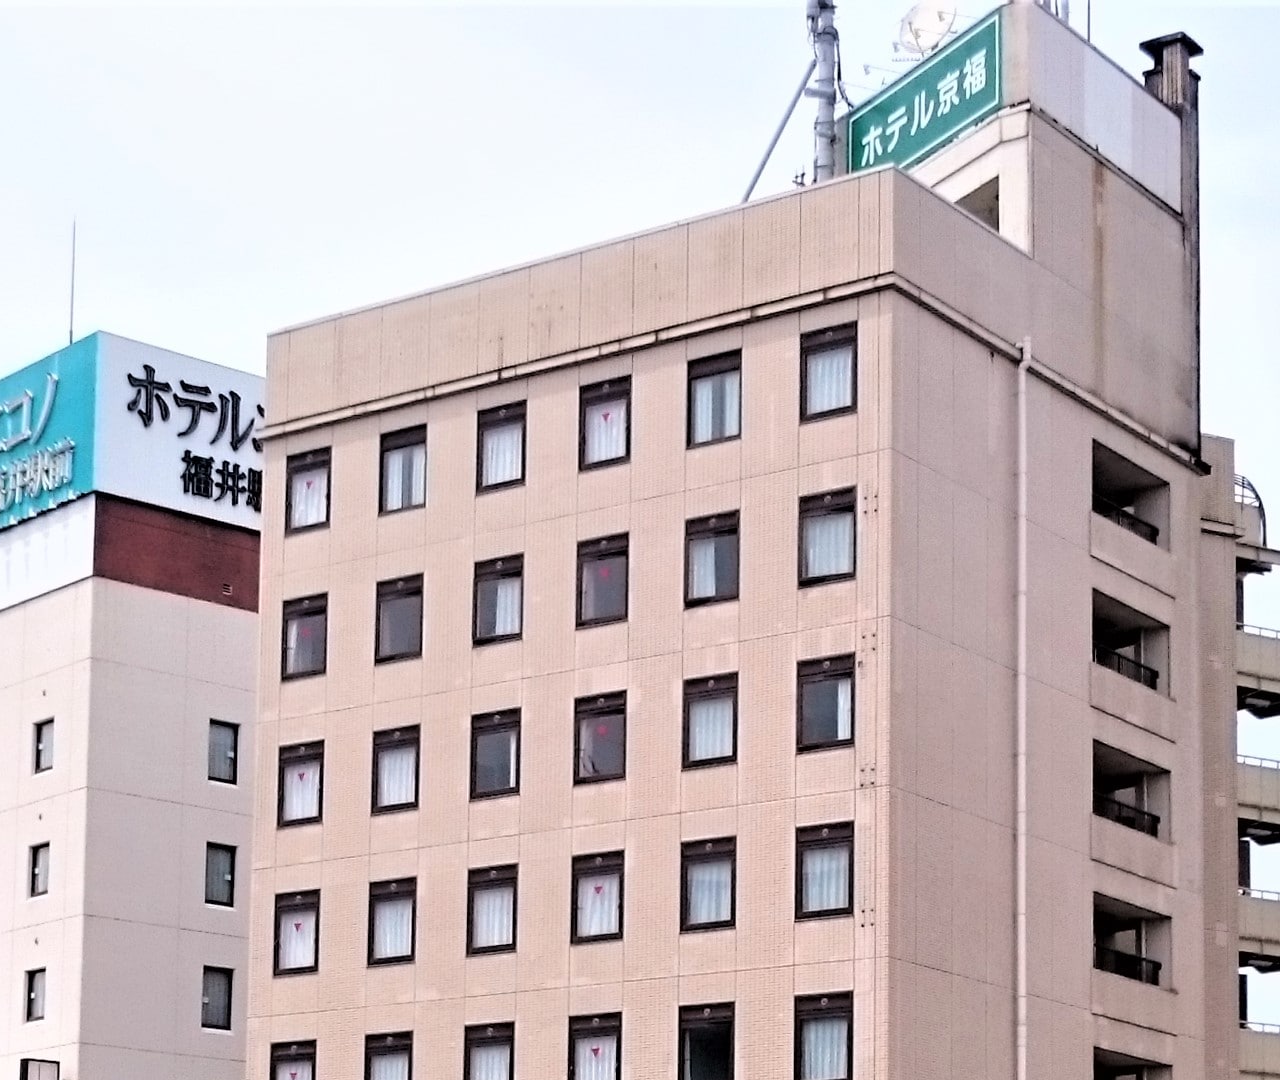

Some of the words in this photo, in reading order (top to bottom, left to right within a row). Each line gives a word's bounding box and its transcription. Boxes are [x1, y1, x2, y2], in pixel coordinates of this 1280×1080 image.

[861, 49, 987, 167] ホテル京福
